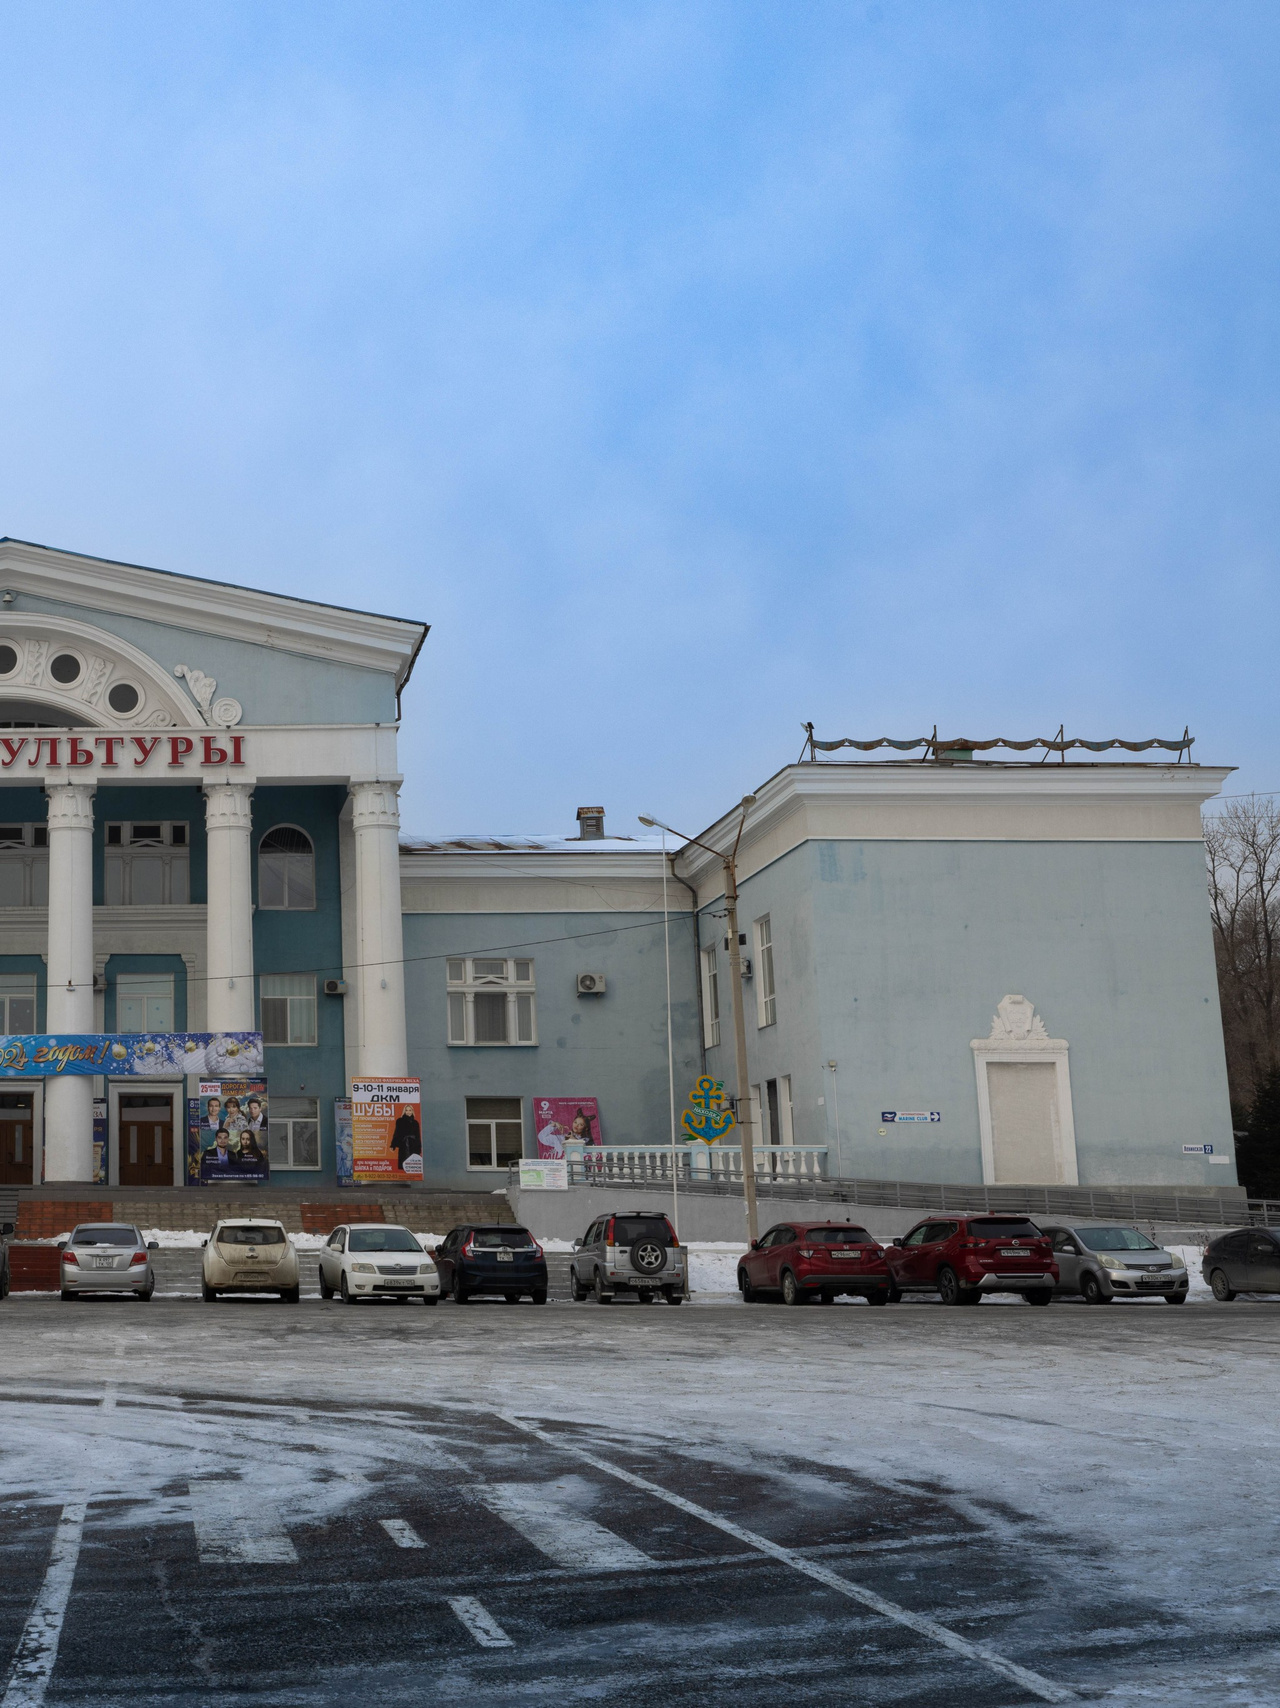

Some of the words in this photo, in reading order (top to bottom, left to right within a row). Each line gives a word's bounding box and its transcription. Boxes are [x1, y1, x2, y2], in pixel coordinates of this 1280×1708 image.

[200, 1084, 208, 1093] 25
[352, 1084, 384, 1092] 9-10-11
[386, 1086, 420, 1094] января
[370, 1094, 400, 1103] ДКМ
[353, 1104, 395, 1116] ШУБЫ
[540, 1101, 550, 1110] 9
[694, 1107, 721, 1121] НАХОДКА
[1204, 1145, 1212, 1153] 22
